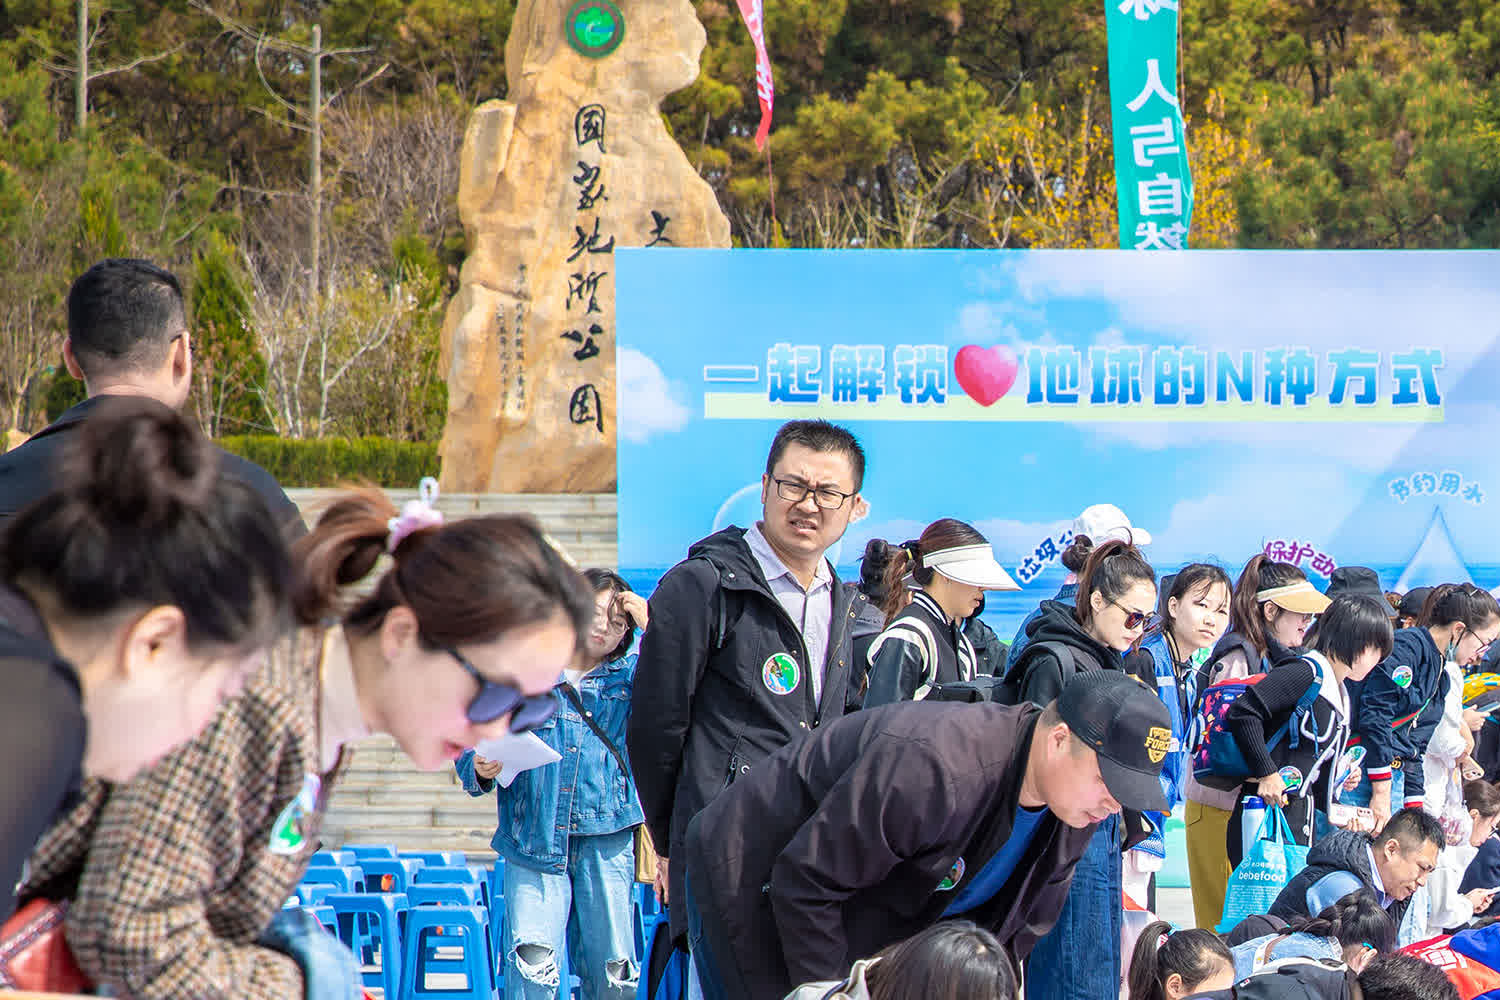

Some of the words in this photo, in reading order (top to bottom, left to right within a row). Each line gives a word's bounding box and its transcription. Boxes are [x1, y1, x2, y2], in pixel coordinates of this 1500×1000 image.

[704, 343, 948, 406] 一起解锁
[1025, 345, 1446, 407] 地球的N种方式
[1388, 471, 1485, 503] 节约用水
